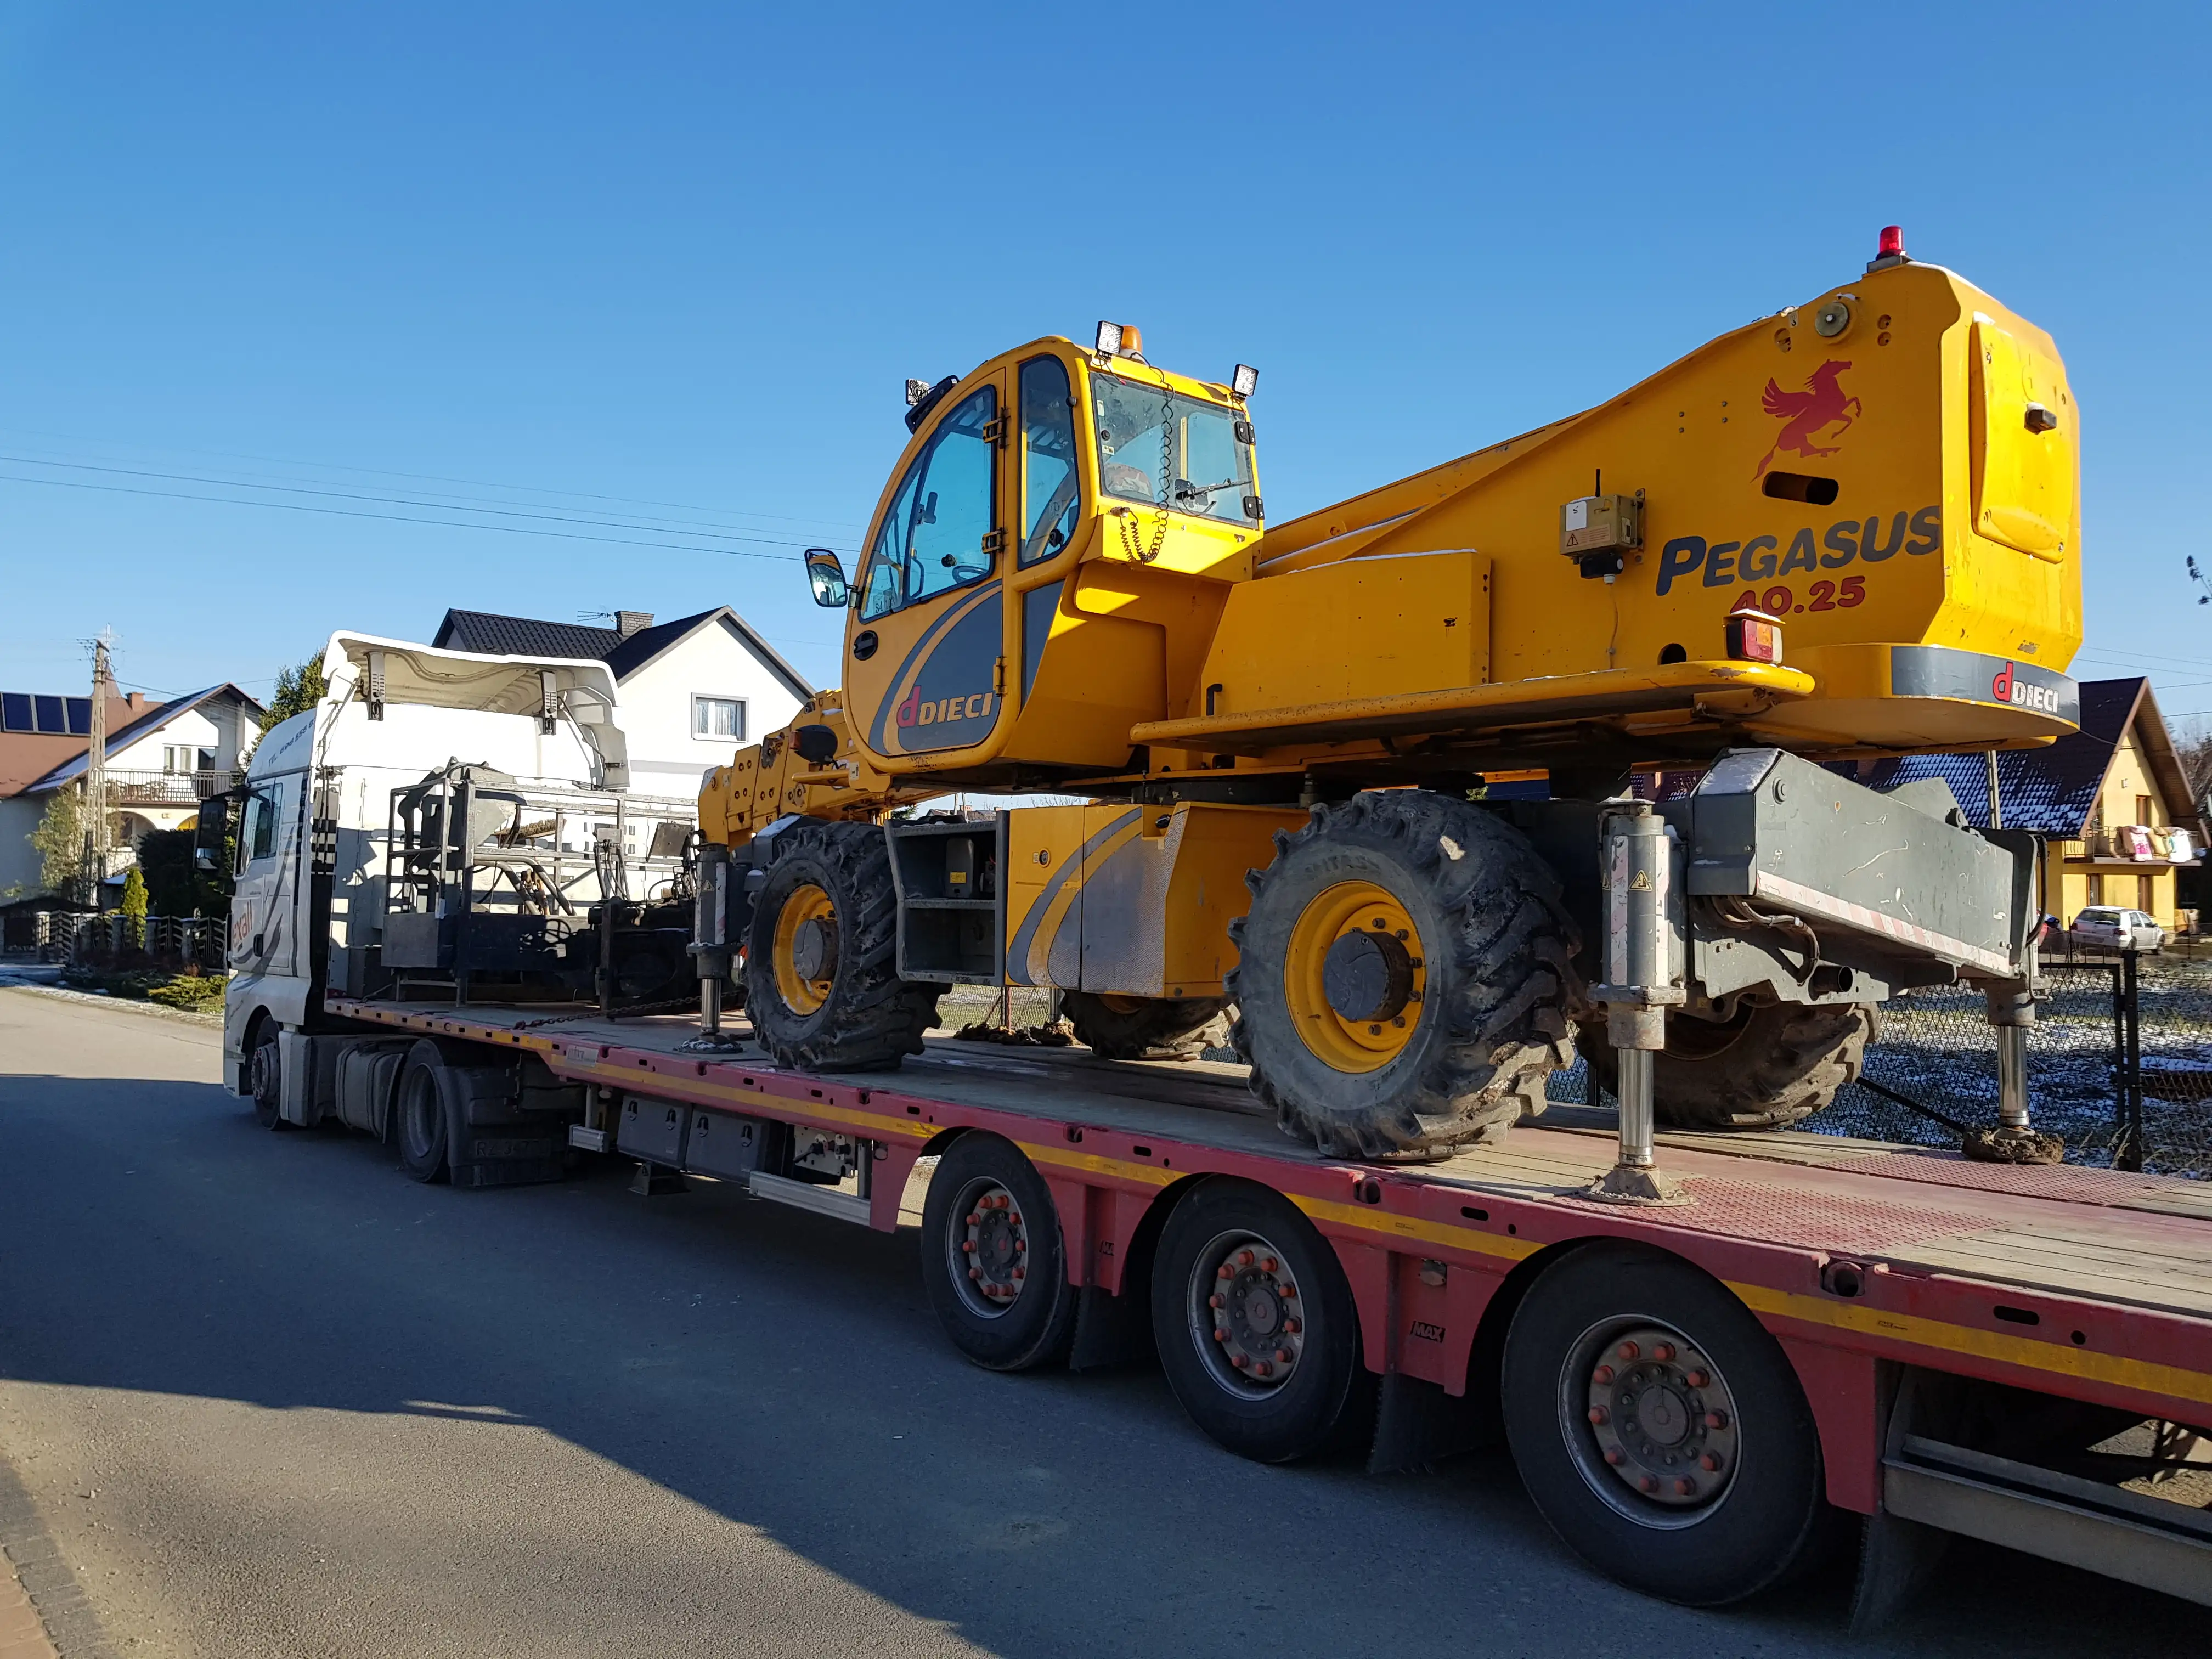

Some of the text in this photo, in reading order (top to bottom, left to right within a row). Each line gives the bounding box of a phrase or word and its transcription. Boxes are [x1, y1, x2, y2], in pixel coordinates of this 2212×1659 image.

[1656, 505, 1940, 596] PEGASUS
[1729, 575, 1866, 616] 40.25
[1410, 1320, 1446, 1343] MAX
